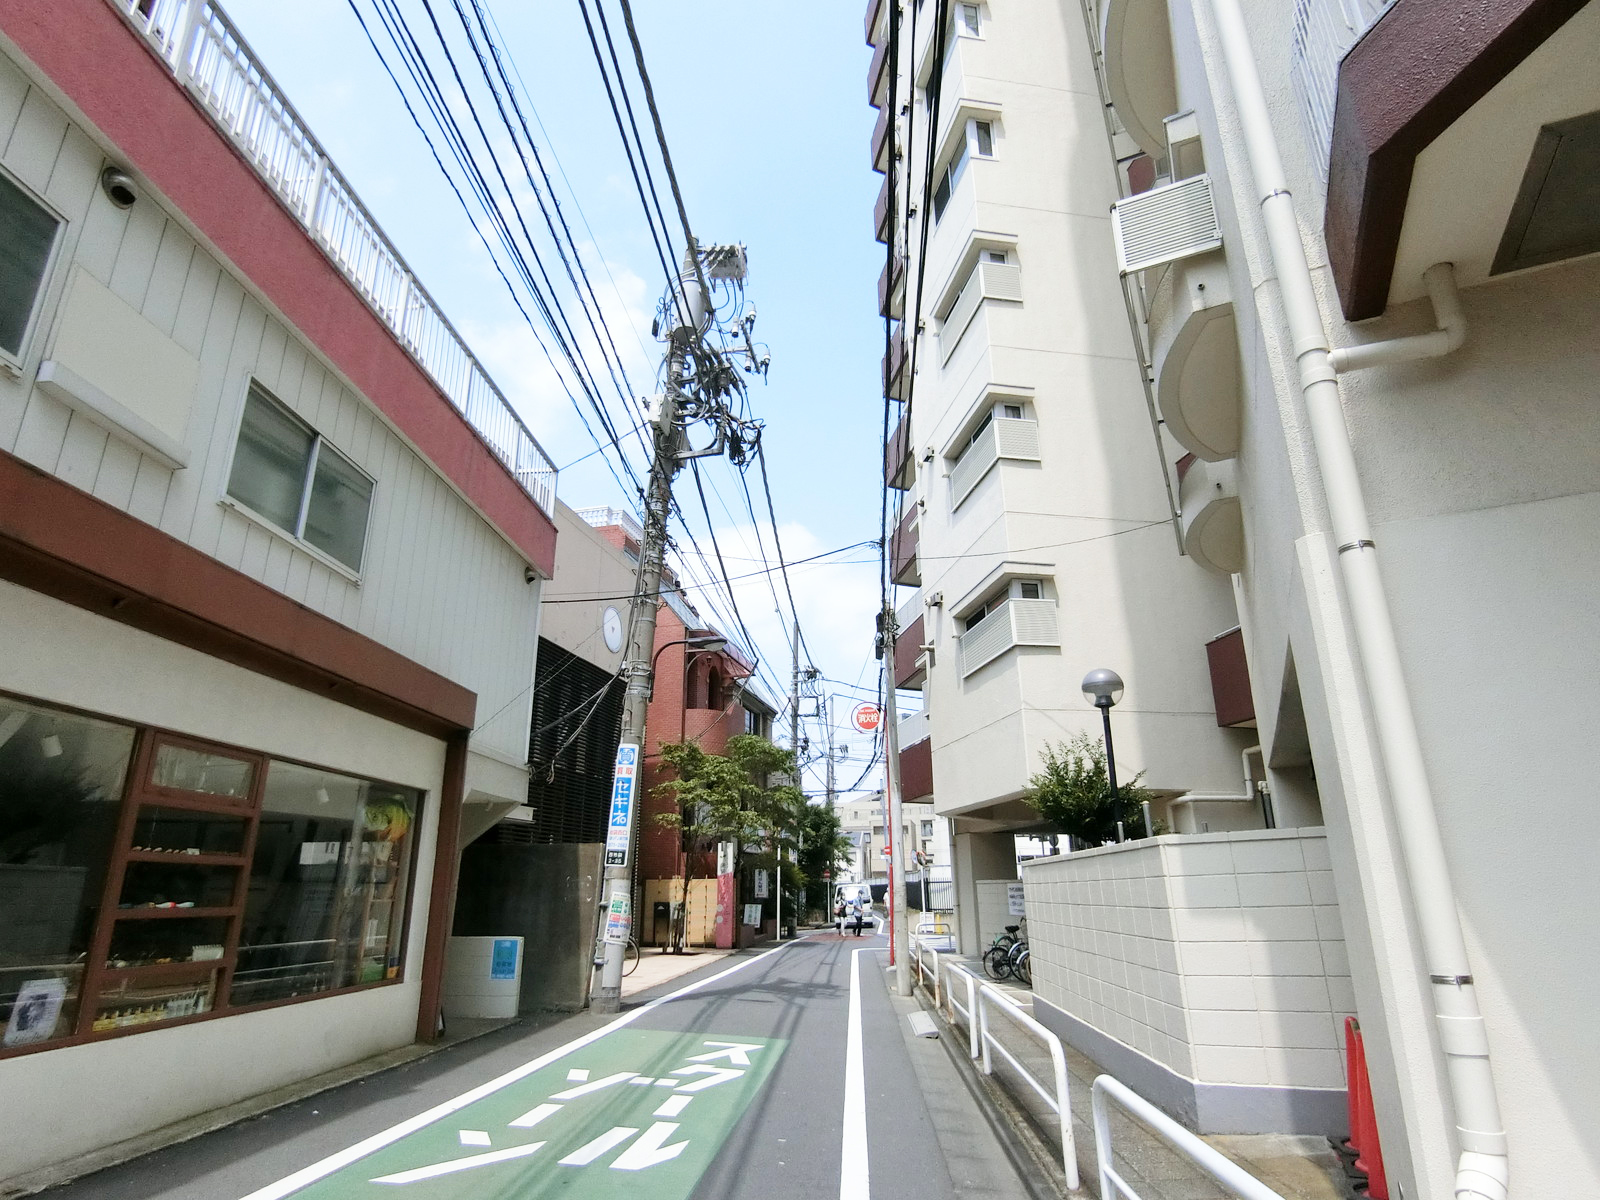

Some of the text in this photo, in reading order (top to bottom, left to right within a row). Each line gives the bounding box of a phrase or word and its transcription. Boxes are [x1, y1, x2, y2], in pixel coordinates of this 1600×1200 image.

[858, 712, 878, 723] 消火栓
[613, 780, 630, 824] セキネ
[368, 1068, 680, 1184] ゾーン
[557, 1041, 765, 1171] スクール
